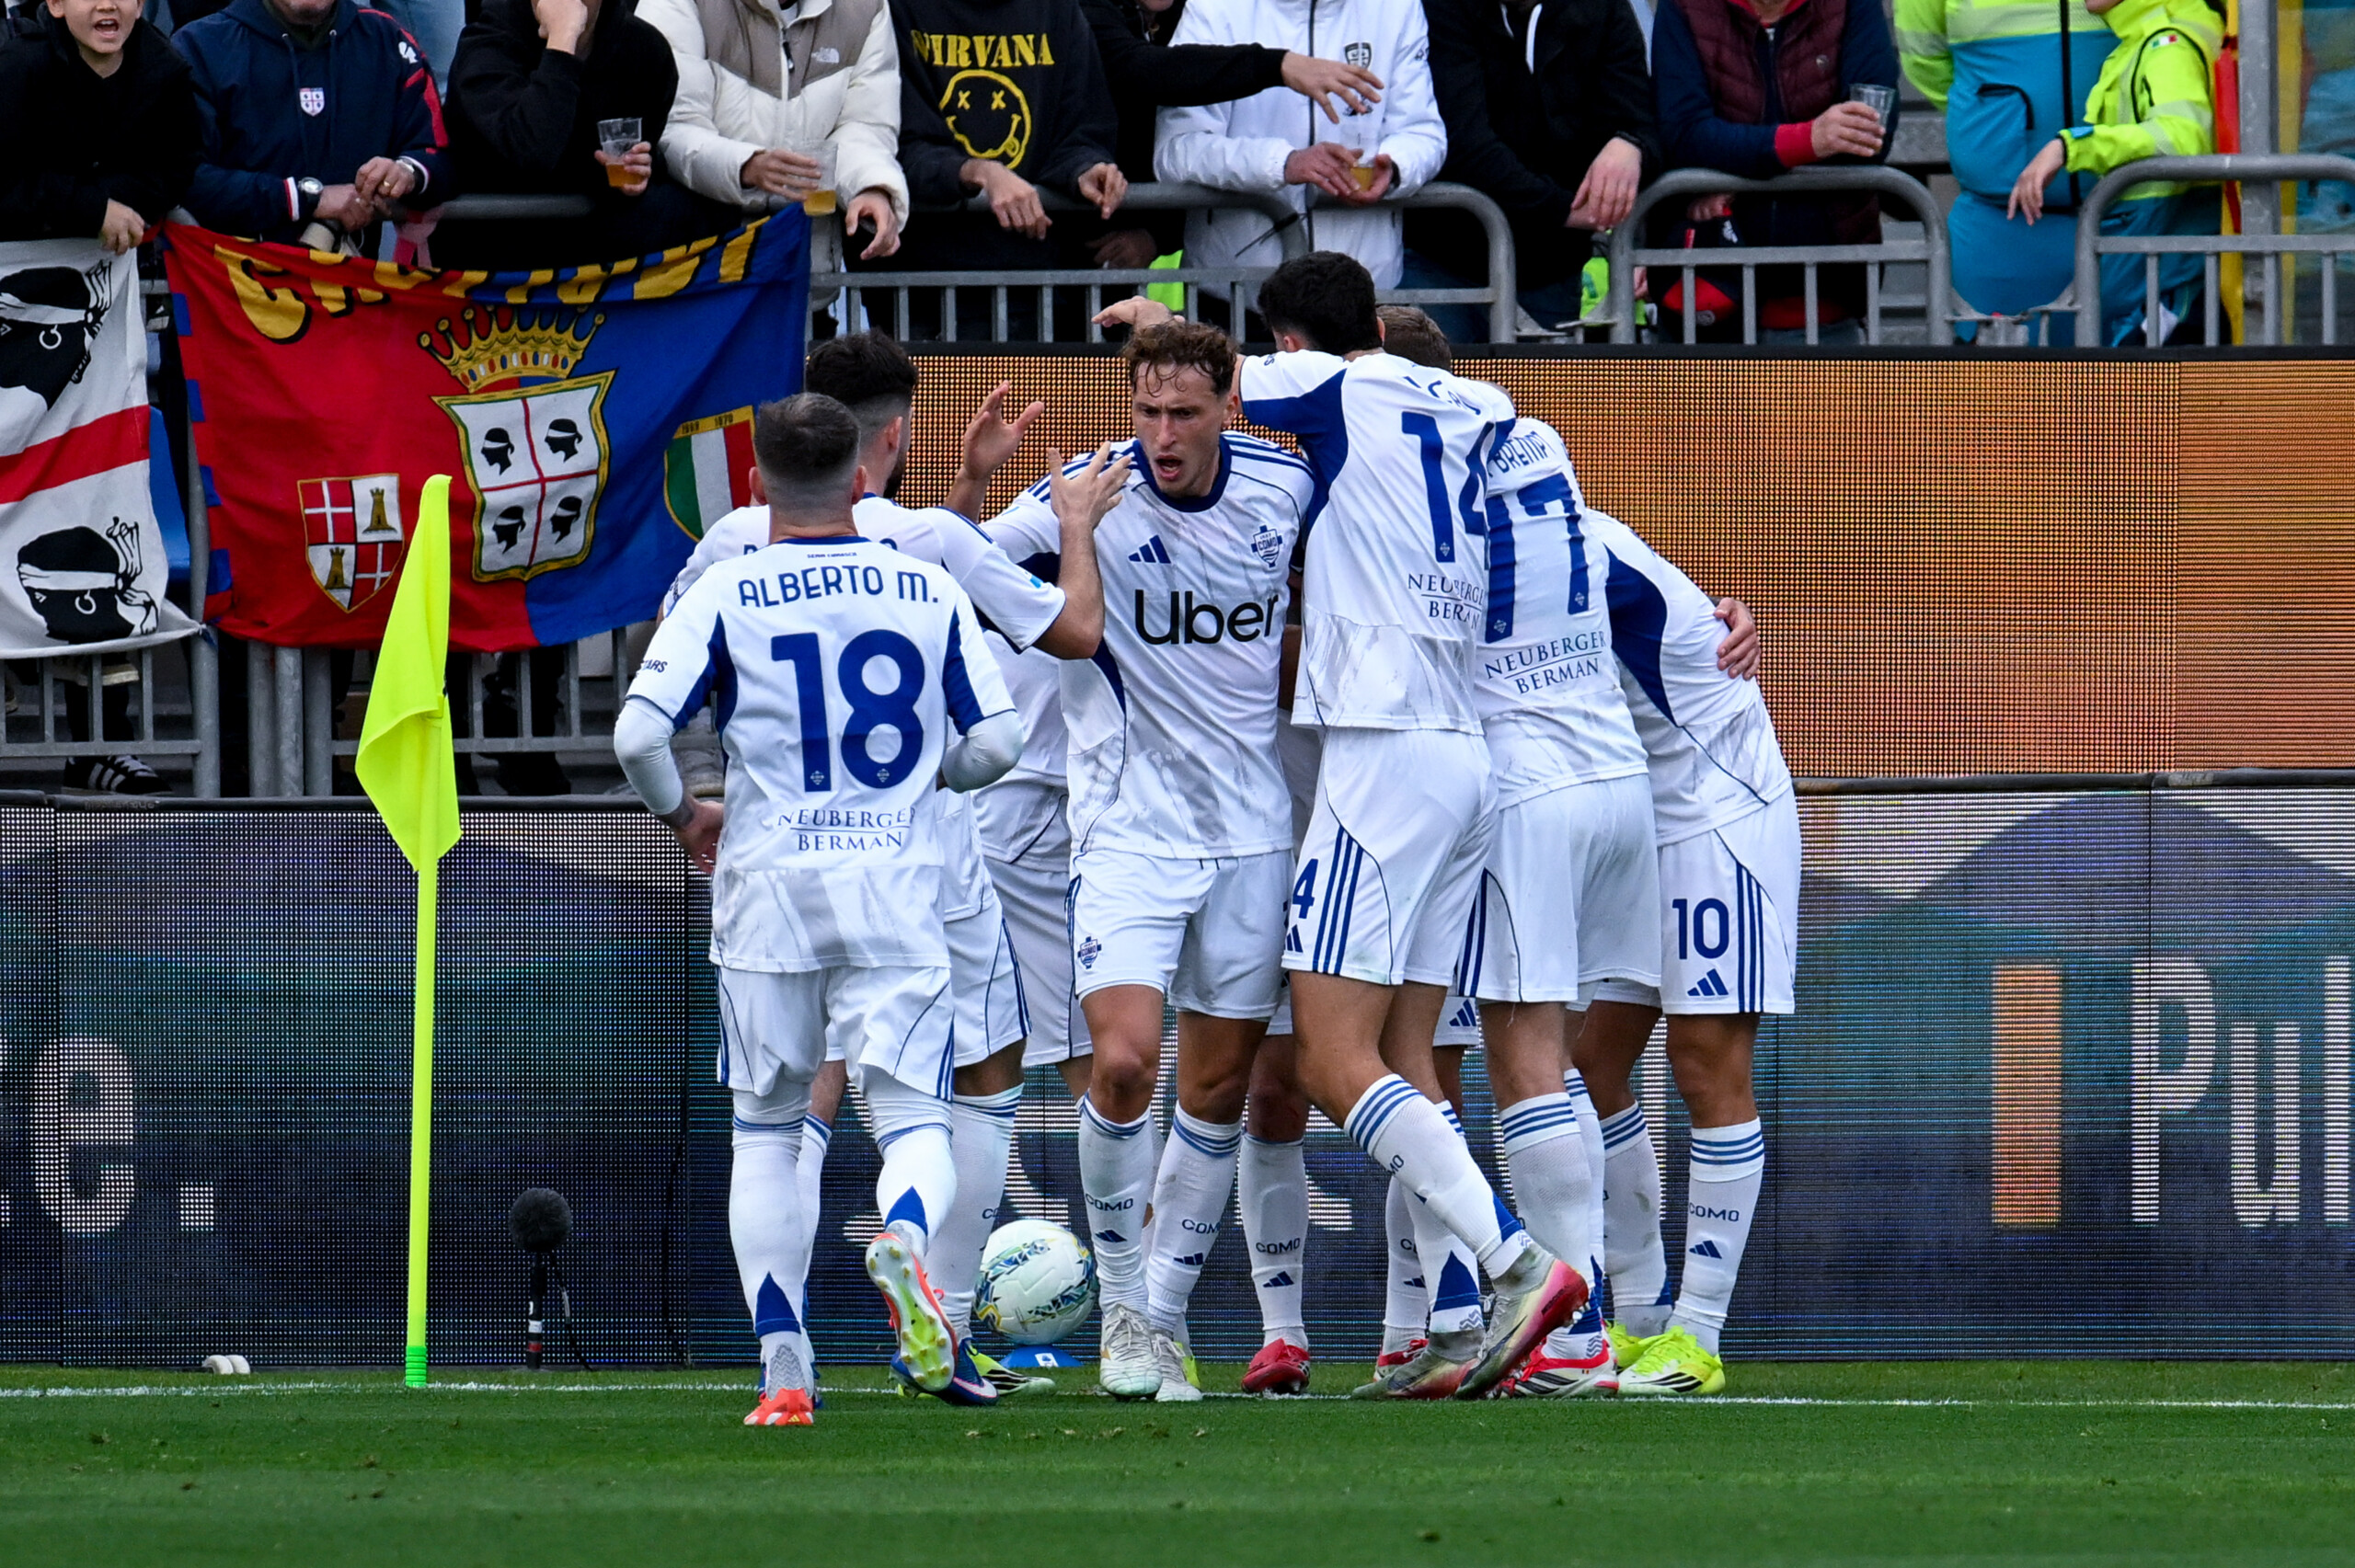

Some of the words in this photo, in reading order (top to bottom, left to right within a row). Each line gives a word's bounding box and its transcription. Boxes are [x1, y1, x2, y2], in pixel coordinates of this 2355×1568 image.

[911, 29, 1055, 68] NIRVANA
[1485, 472, 1590, 645] 17
[738, 566, 883, 607] ALBERTO
[897, 571, 938, 603] M.
[1135, 589, 1279, 645] Uber
[1484, 631, 1607, 680] NEUBERGER
[1515, 658, 1599, 694] BERMAN
[771, 629, 925, 793] 18
[798, 831, 902, 851] BERMAN
[1671, 898, 1729, 959] 10
[1086, 1194, 1133, 1211] COMO
[1689, 1202, 1740, 1222] COMO
[1182, 1219, 1221, 1234] COM
[1255, 1237, 1301, 1254] COMO
